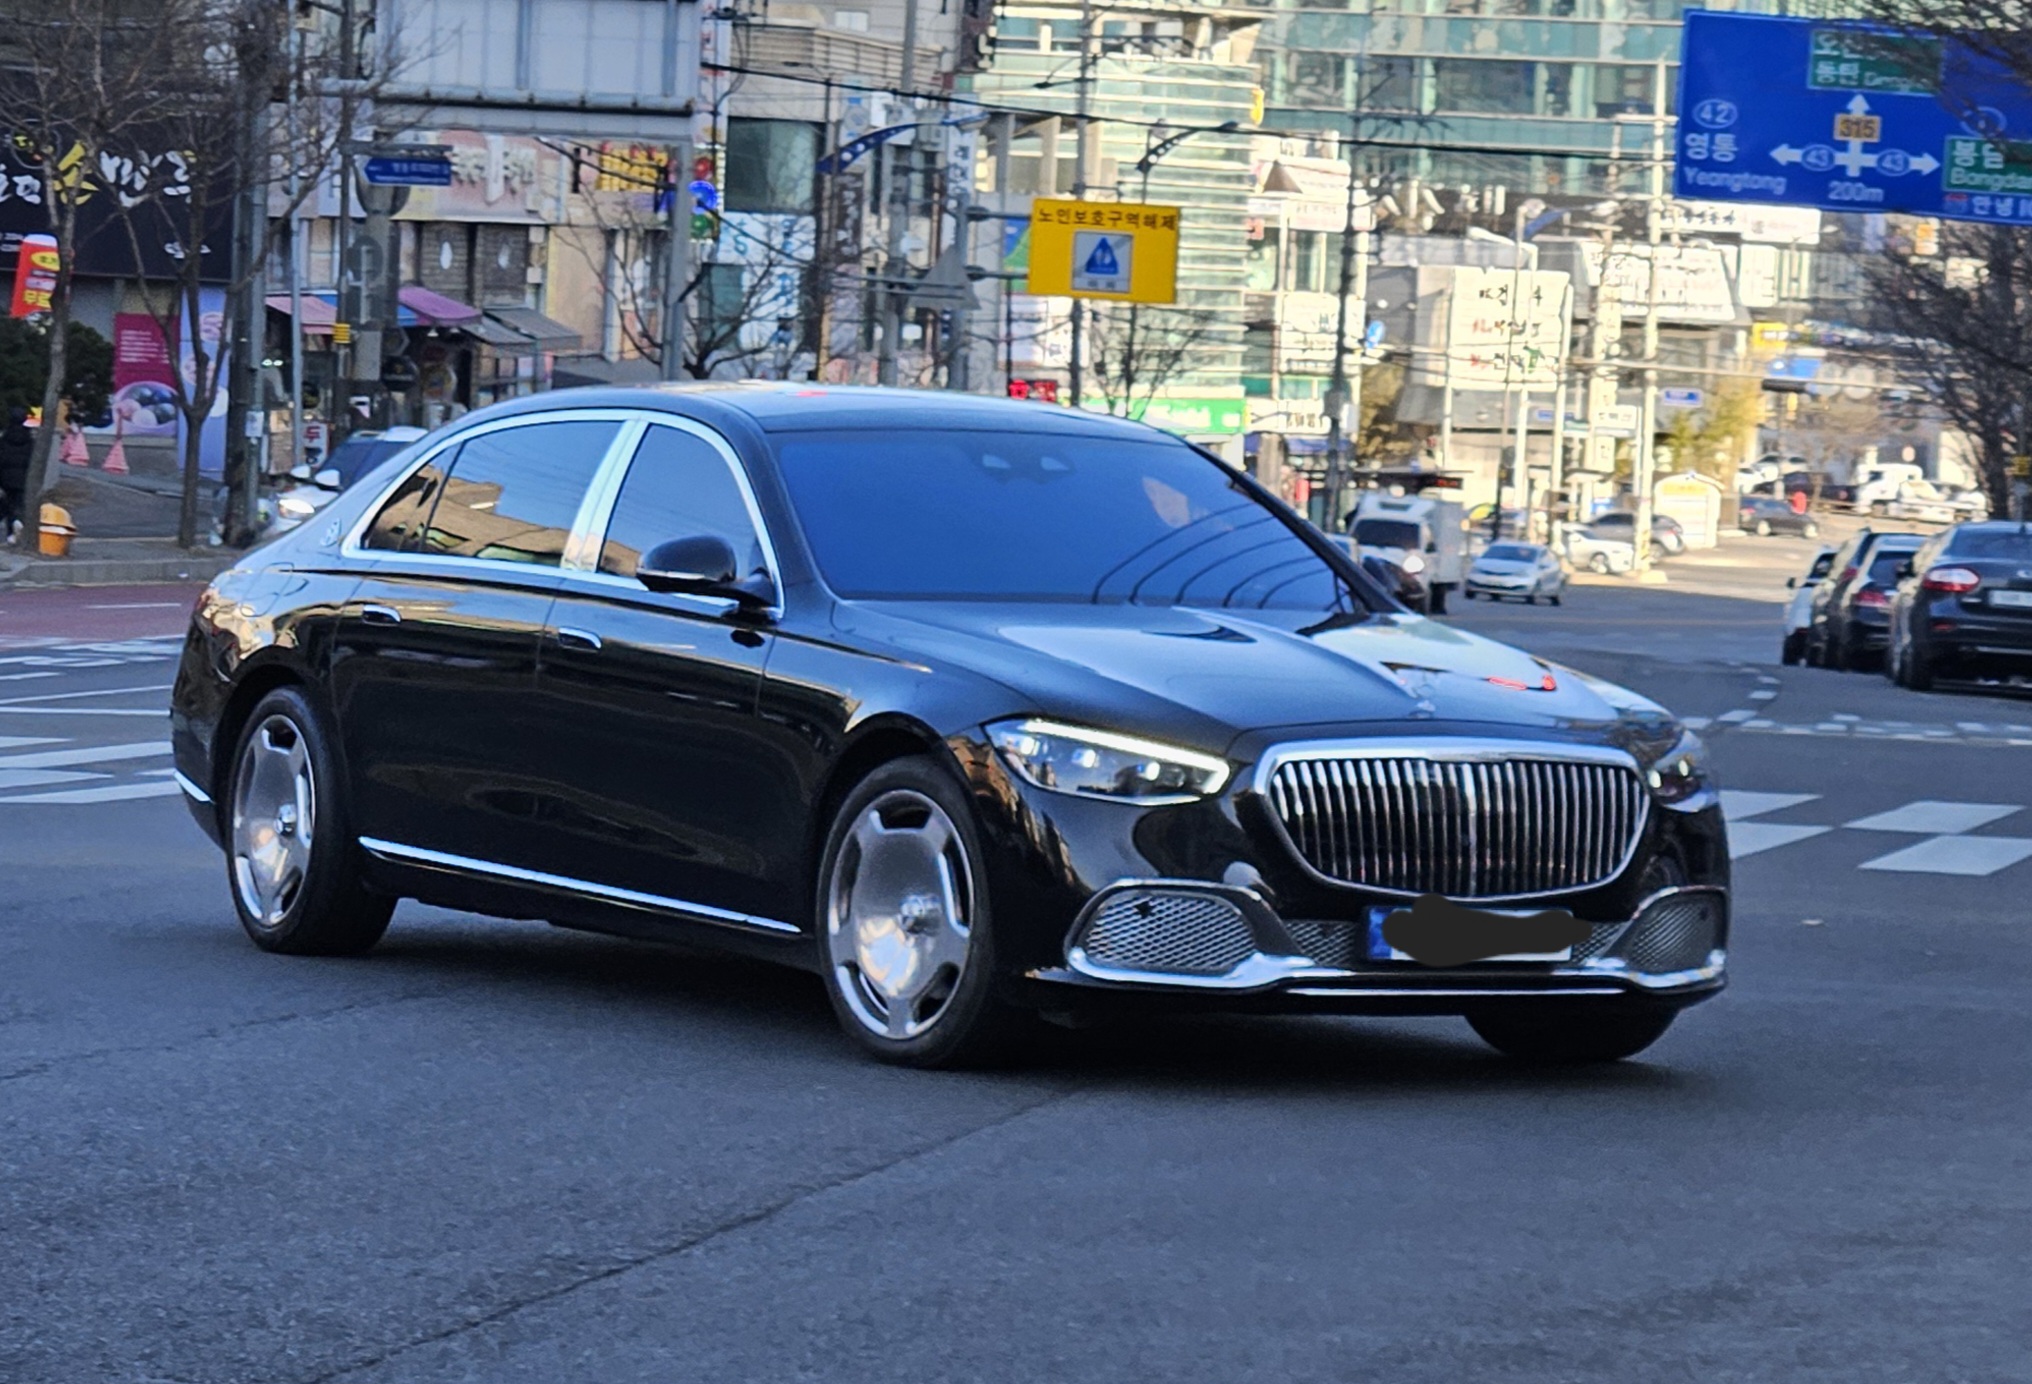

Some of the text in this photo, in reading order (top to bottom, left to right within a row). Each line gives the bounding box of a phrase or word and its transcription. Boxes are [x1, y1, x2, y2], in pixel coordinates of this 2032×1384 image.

[1700, 104, 1729, 124] 42
[1838, 115, 1877, 138] 315
[1684, 132, 1739, 163] 영통
[1806, 149, 1830, 167] 43
[1881, 153, 1905, 172] 43
[1683, 167, 1787, 196] Yeongtong
[1950, 166, 2032, 192] Bongda
[1827, 180, 1885, 203] 200m
[1037, 207, 1177, 231] 노인보호구역해제
